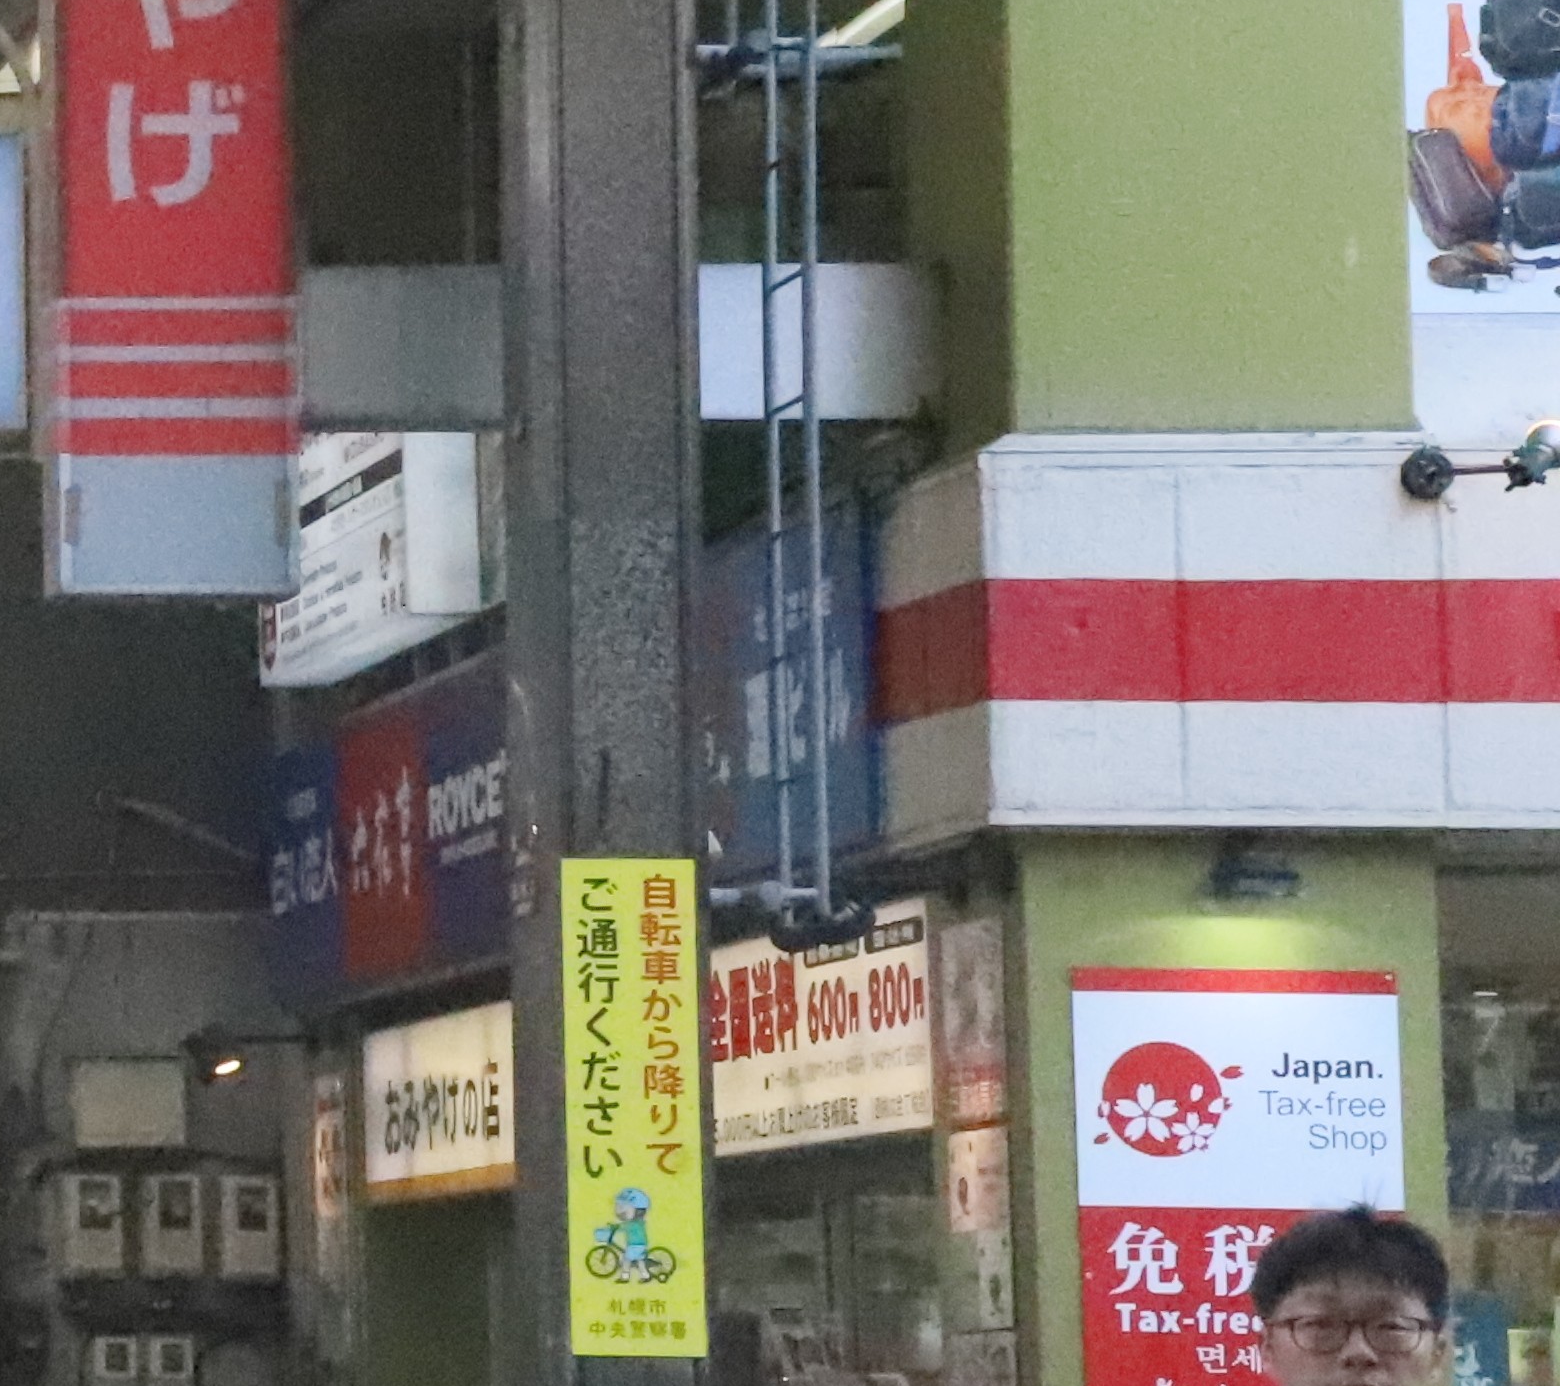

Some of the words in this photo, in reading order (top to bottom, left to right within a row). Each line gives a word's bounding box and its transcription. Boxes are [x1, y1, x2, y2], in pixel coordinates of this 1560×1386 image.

[576, 875, 624, 1179] ご通行ください
[638, 873, 686, 1176] 自転車から降りて
[1271, 1051, 1385, 1083] Japan.
[383, 1054, 502, 1156] おみやげの店
[1258, 1089, 1386, 1119] Tax-free
[1308, 1123, 1388, 1157] Shop
[606, 1297, 666, 1315] 札幌市
